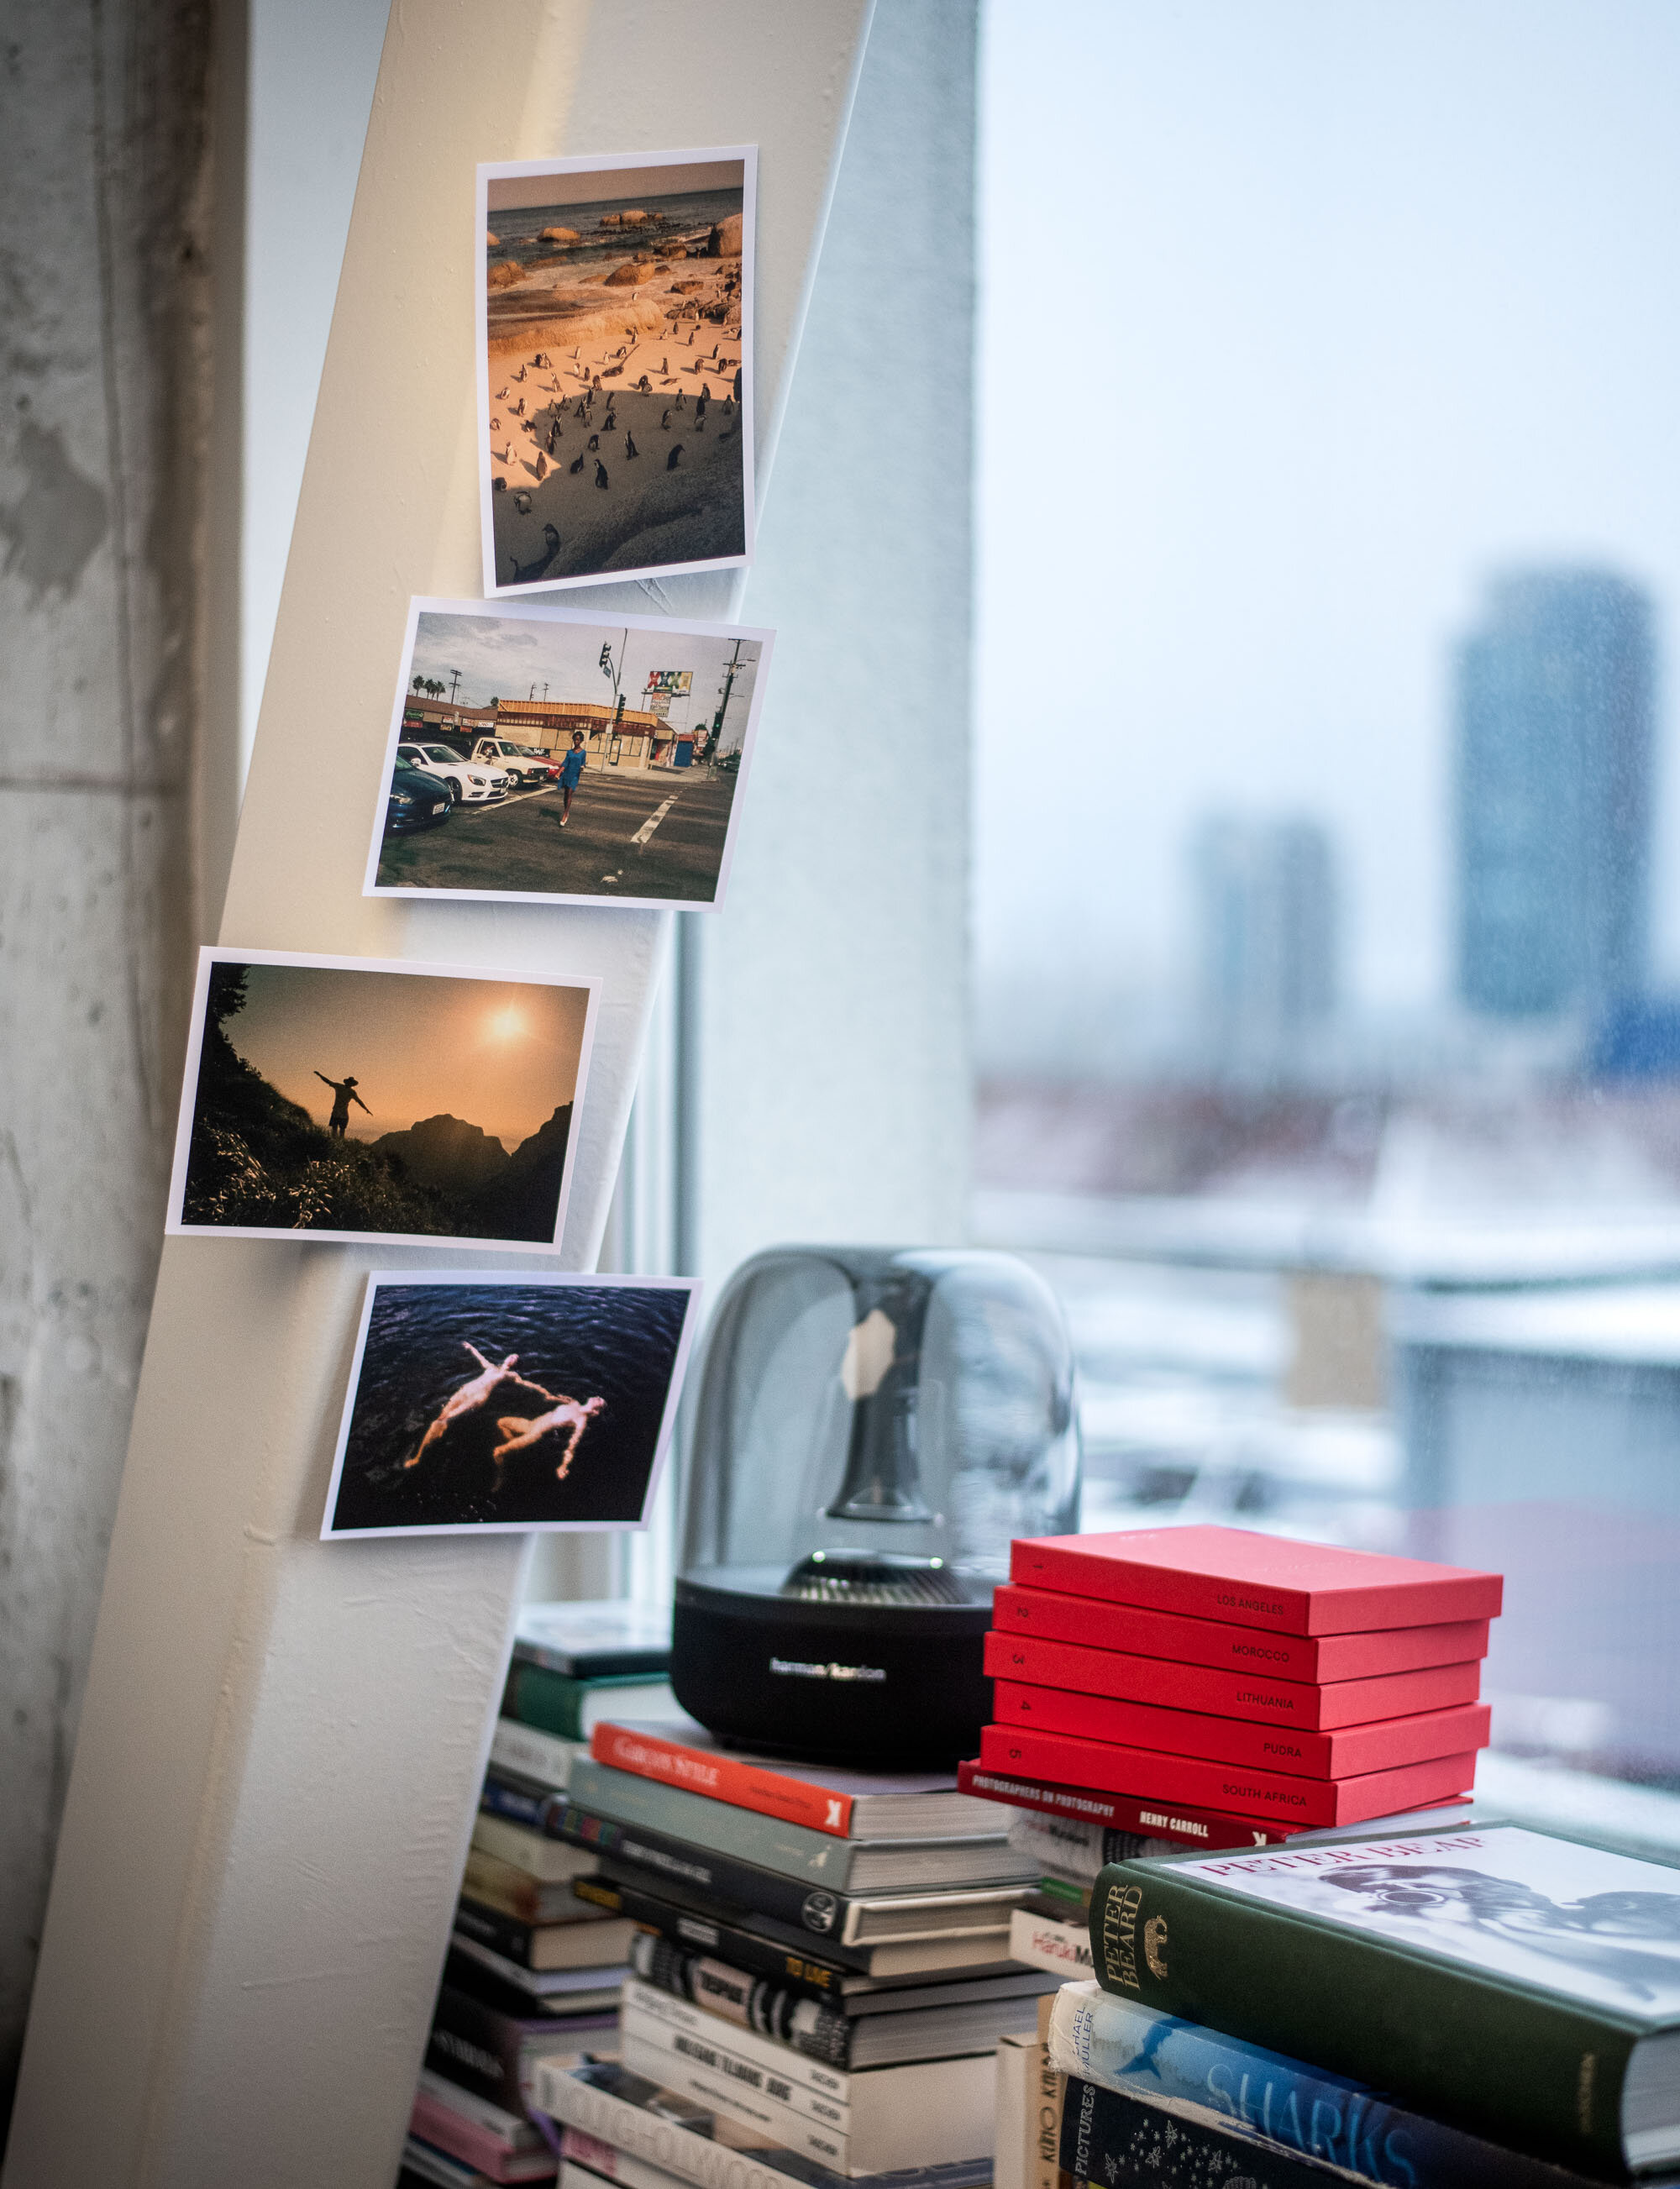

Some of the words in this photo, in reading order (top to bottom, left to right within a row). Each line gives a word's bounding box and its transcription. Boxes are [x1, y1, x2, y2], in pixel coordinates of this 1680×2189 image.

[1016, 1607, 1028, 1618] 2
[1216, 1594, 1236, 1607] LOS
[1238, 1598, 1284, 1615] ANGELES
[1012, 1654, 1025, 1665] 3
[1231, 1644, 1289, 1663] MOROCCO
[1021, 1700, 1032, 1711] 4
[1236, 1692, 1294, 1709] LITHUANIA
[1009, 1748, 1021, 1760] 5
[1263, 1742, 1302, 1757] PUDRA
[1222, 1783, 1262, 1798] SOUTH
[1264, 1792, 1307, 1807] AFRICA
[972, 1775, 1041, 1801] PHOTOGRAPHERS
[1042, 1791, 1055, 1803] ON
[1055, 1793, 1115, 1818] PHOTOGRAPHY
[1139, 1811, 1168, 1829] HENRY
[1169, 1819, 1210, 1838] CARROLL
[1199, 1850, 1368, 1877] PETER
[1103, 1884, 1129, 1984] PETER
[1118, 1885, 1143, 1992] BEARD
[1081, 2012, 1093, 2076] MULLER
[1074, 2083, 1096, 2176] PICTURES
[1206, 2063, 1416, 2188] SHARKS
